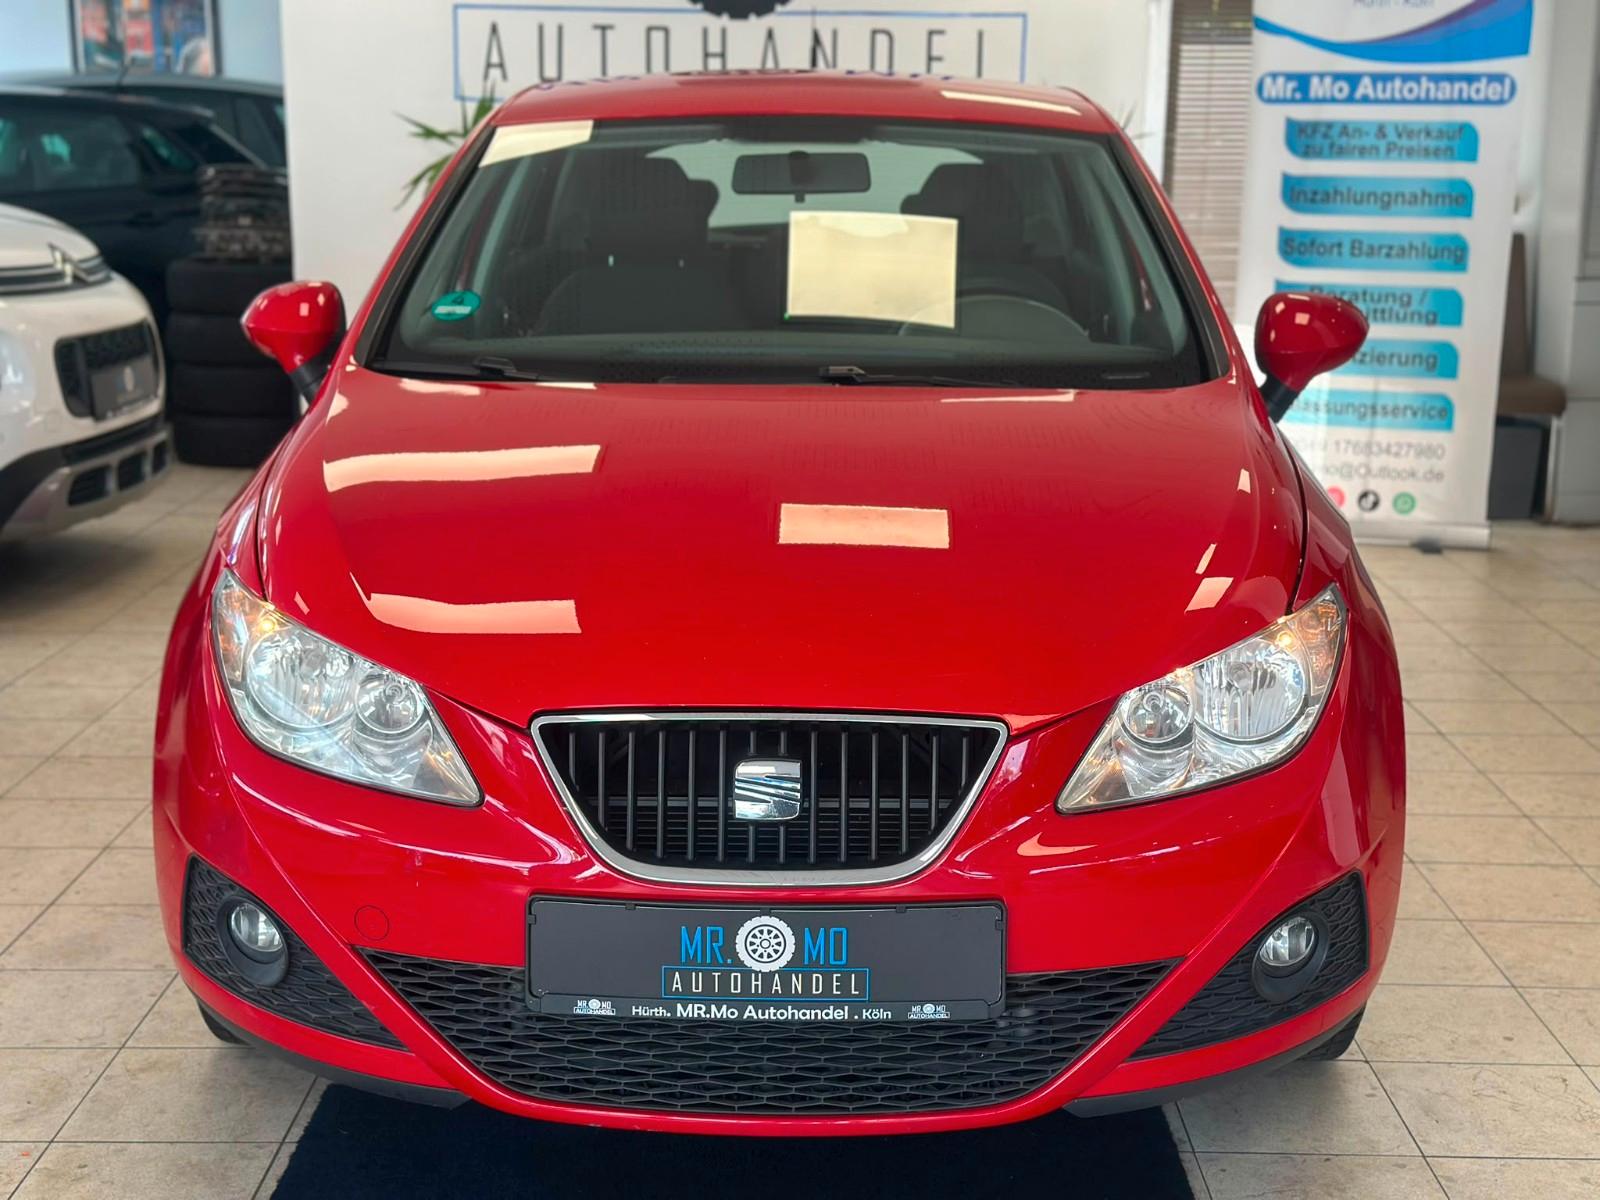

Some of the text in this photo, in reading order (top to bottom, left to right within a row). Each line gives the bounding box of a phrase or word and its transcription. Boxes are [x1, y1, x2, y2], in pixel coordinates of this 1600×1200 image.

[1262, 75, 1511, 100] Mr. Mo Autohandel
[1297, 123, 1464, 140] KFZ An- & Verkauf
[1303, 141, 1457, 158] zu fairen Preisen
[1289, 185, 1467, 210] Inzahlungnahme
[1283, 237, 1466, 264] Sofort Barzahlung
[680, 925, 848, 966] MR. MO
[671, 971, 860, 995] AUTOHANDEL
[632, 1005, 671, 1017] Hürth.
[676, 1003, 739, 1019] MR.Mo
[743, 1005, 849, 1020] Autohandel
[862, 1008, 892, 1020] Köln
